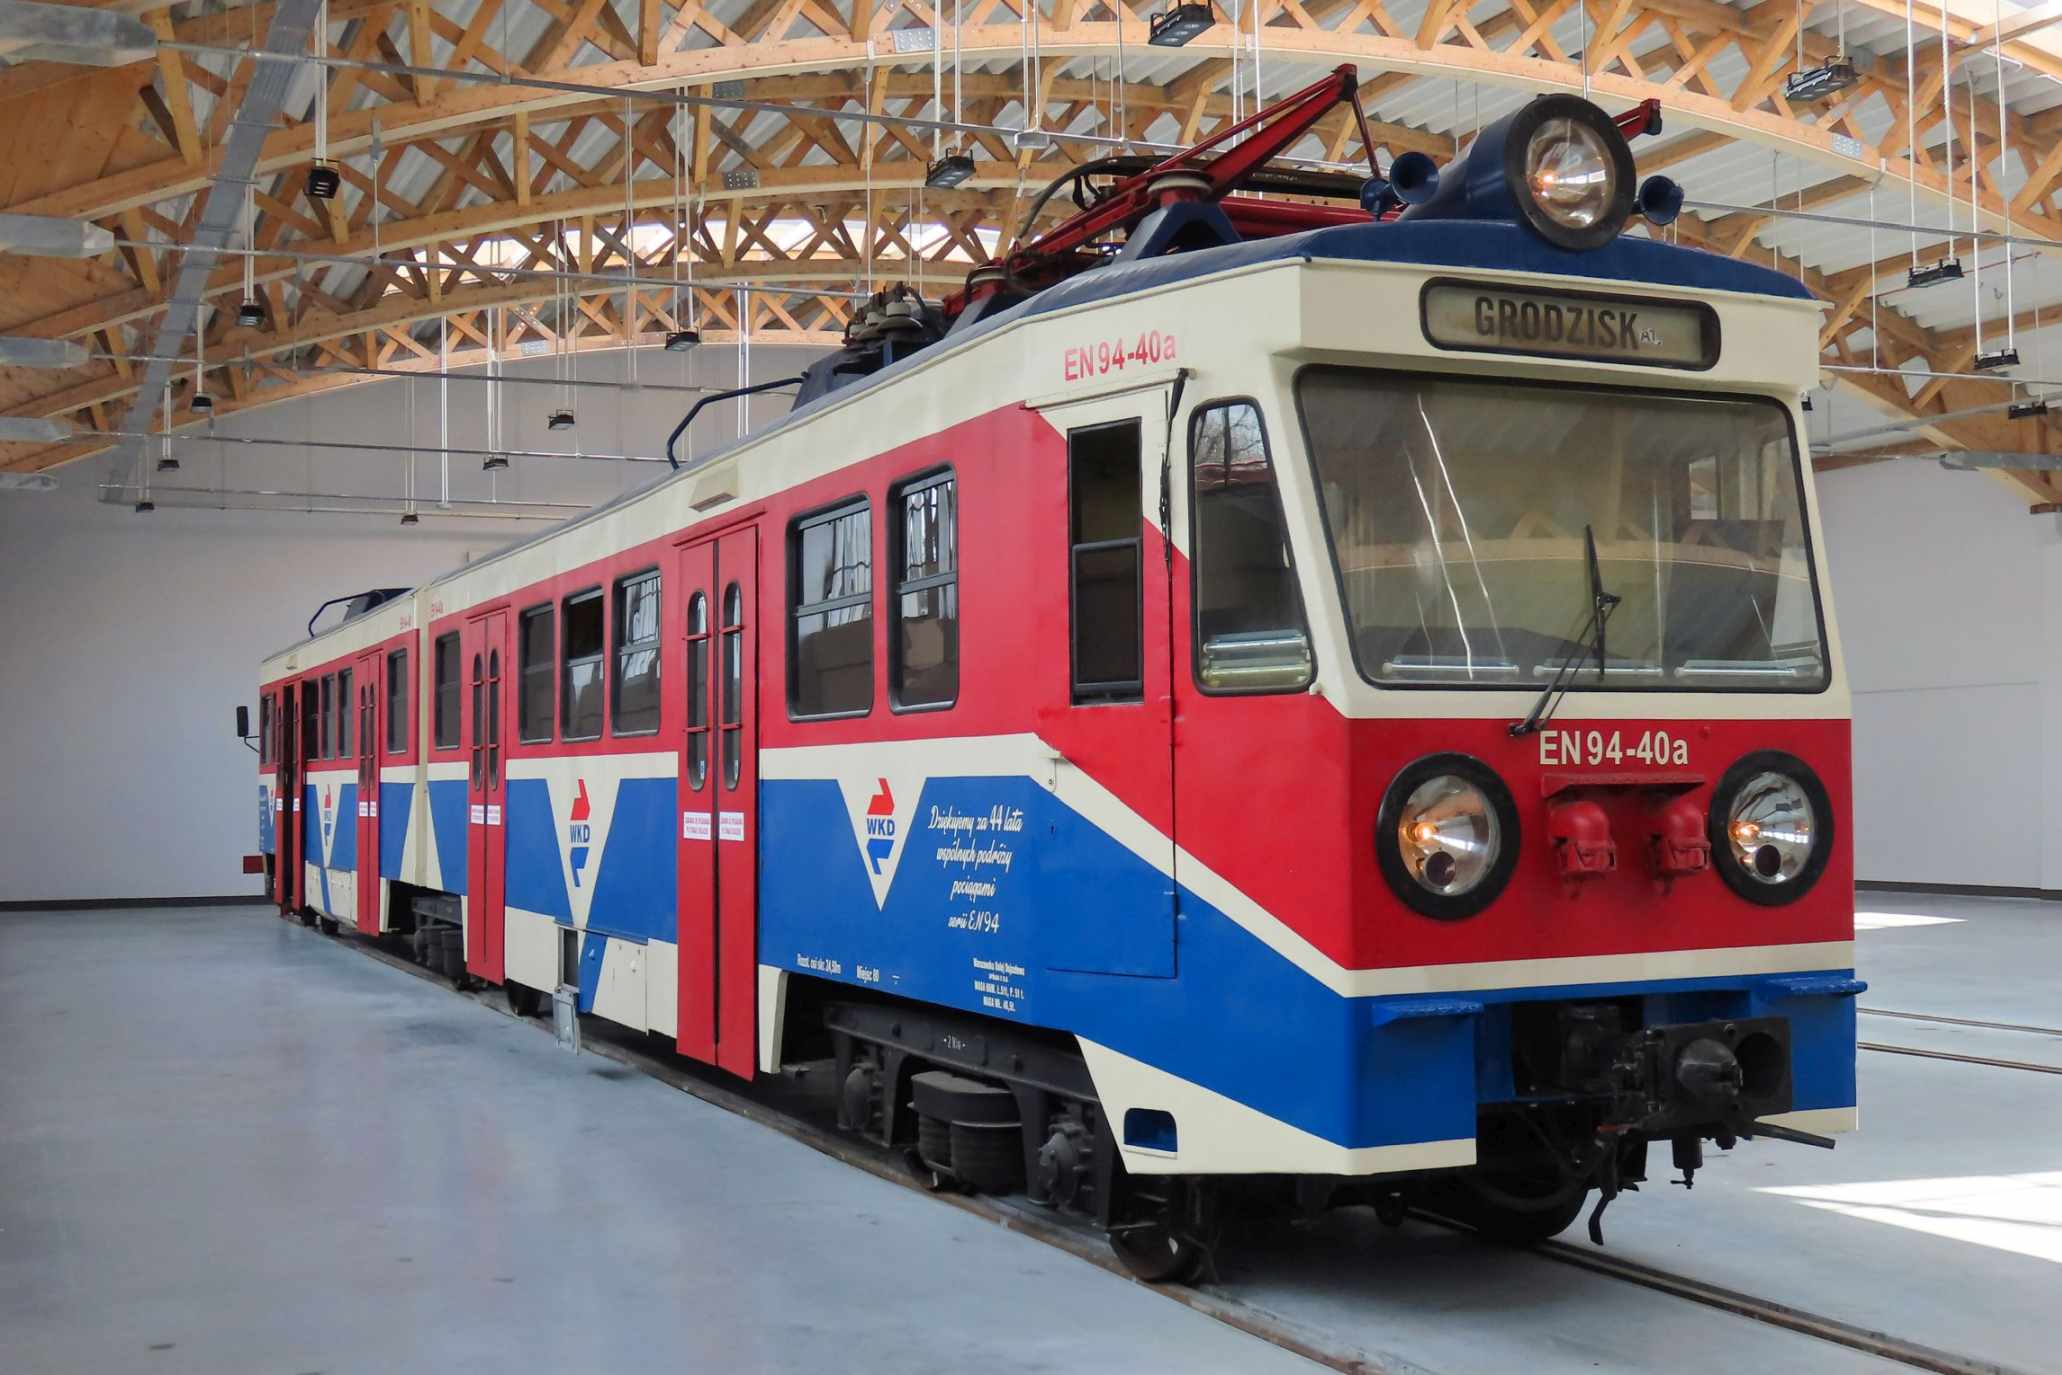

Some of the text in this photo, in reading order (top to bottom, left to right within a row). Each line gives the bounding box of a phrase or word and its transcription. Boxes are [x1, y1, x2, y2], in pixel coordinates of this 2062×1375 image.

[1474, 296, 1639, 350] GRODZISK
[867, 818, 896, 836] WKD
[990, 804, 1004, 831] 44
[1003, 806, 1024, 832] lata
[569, 823, 591, 844] WKD
